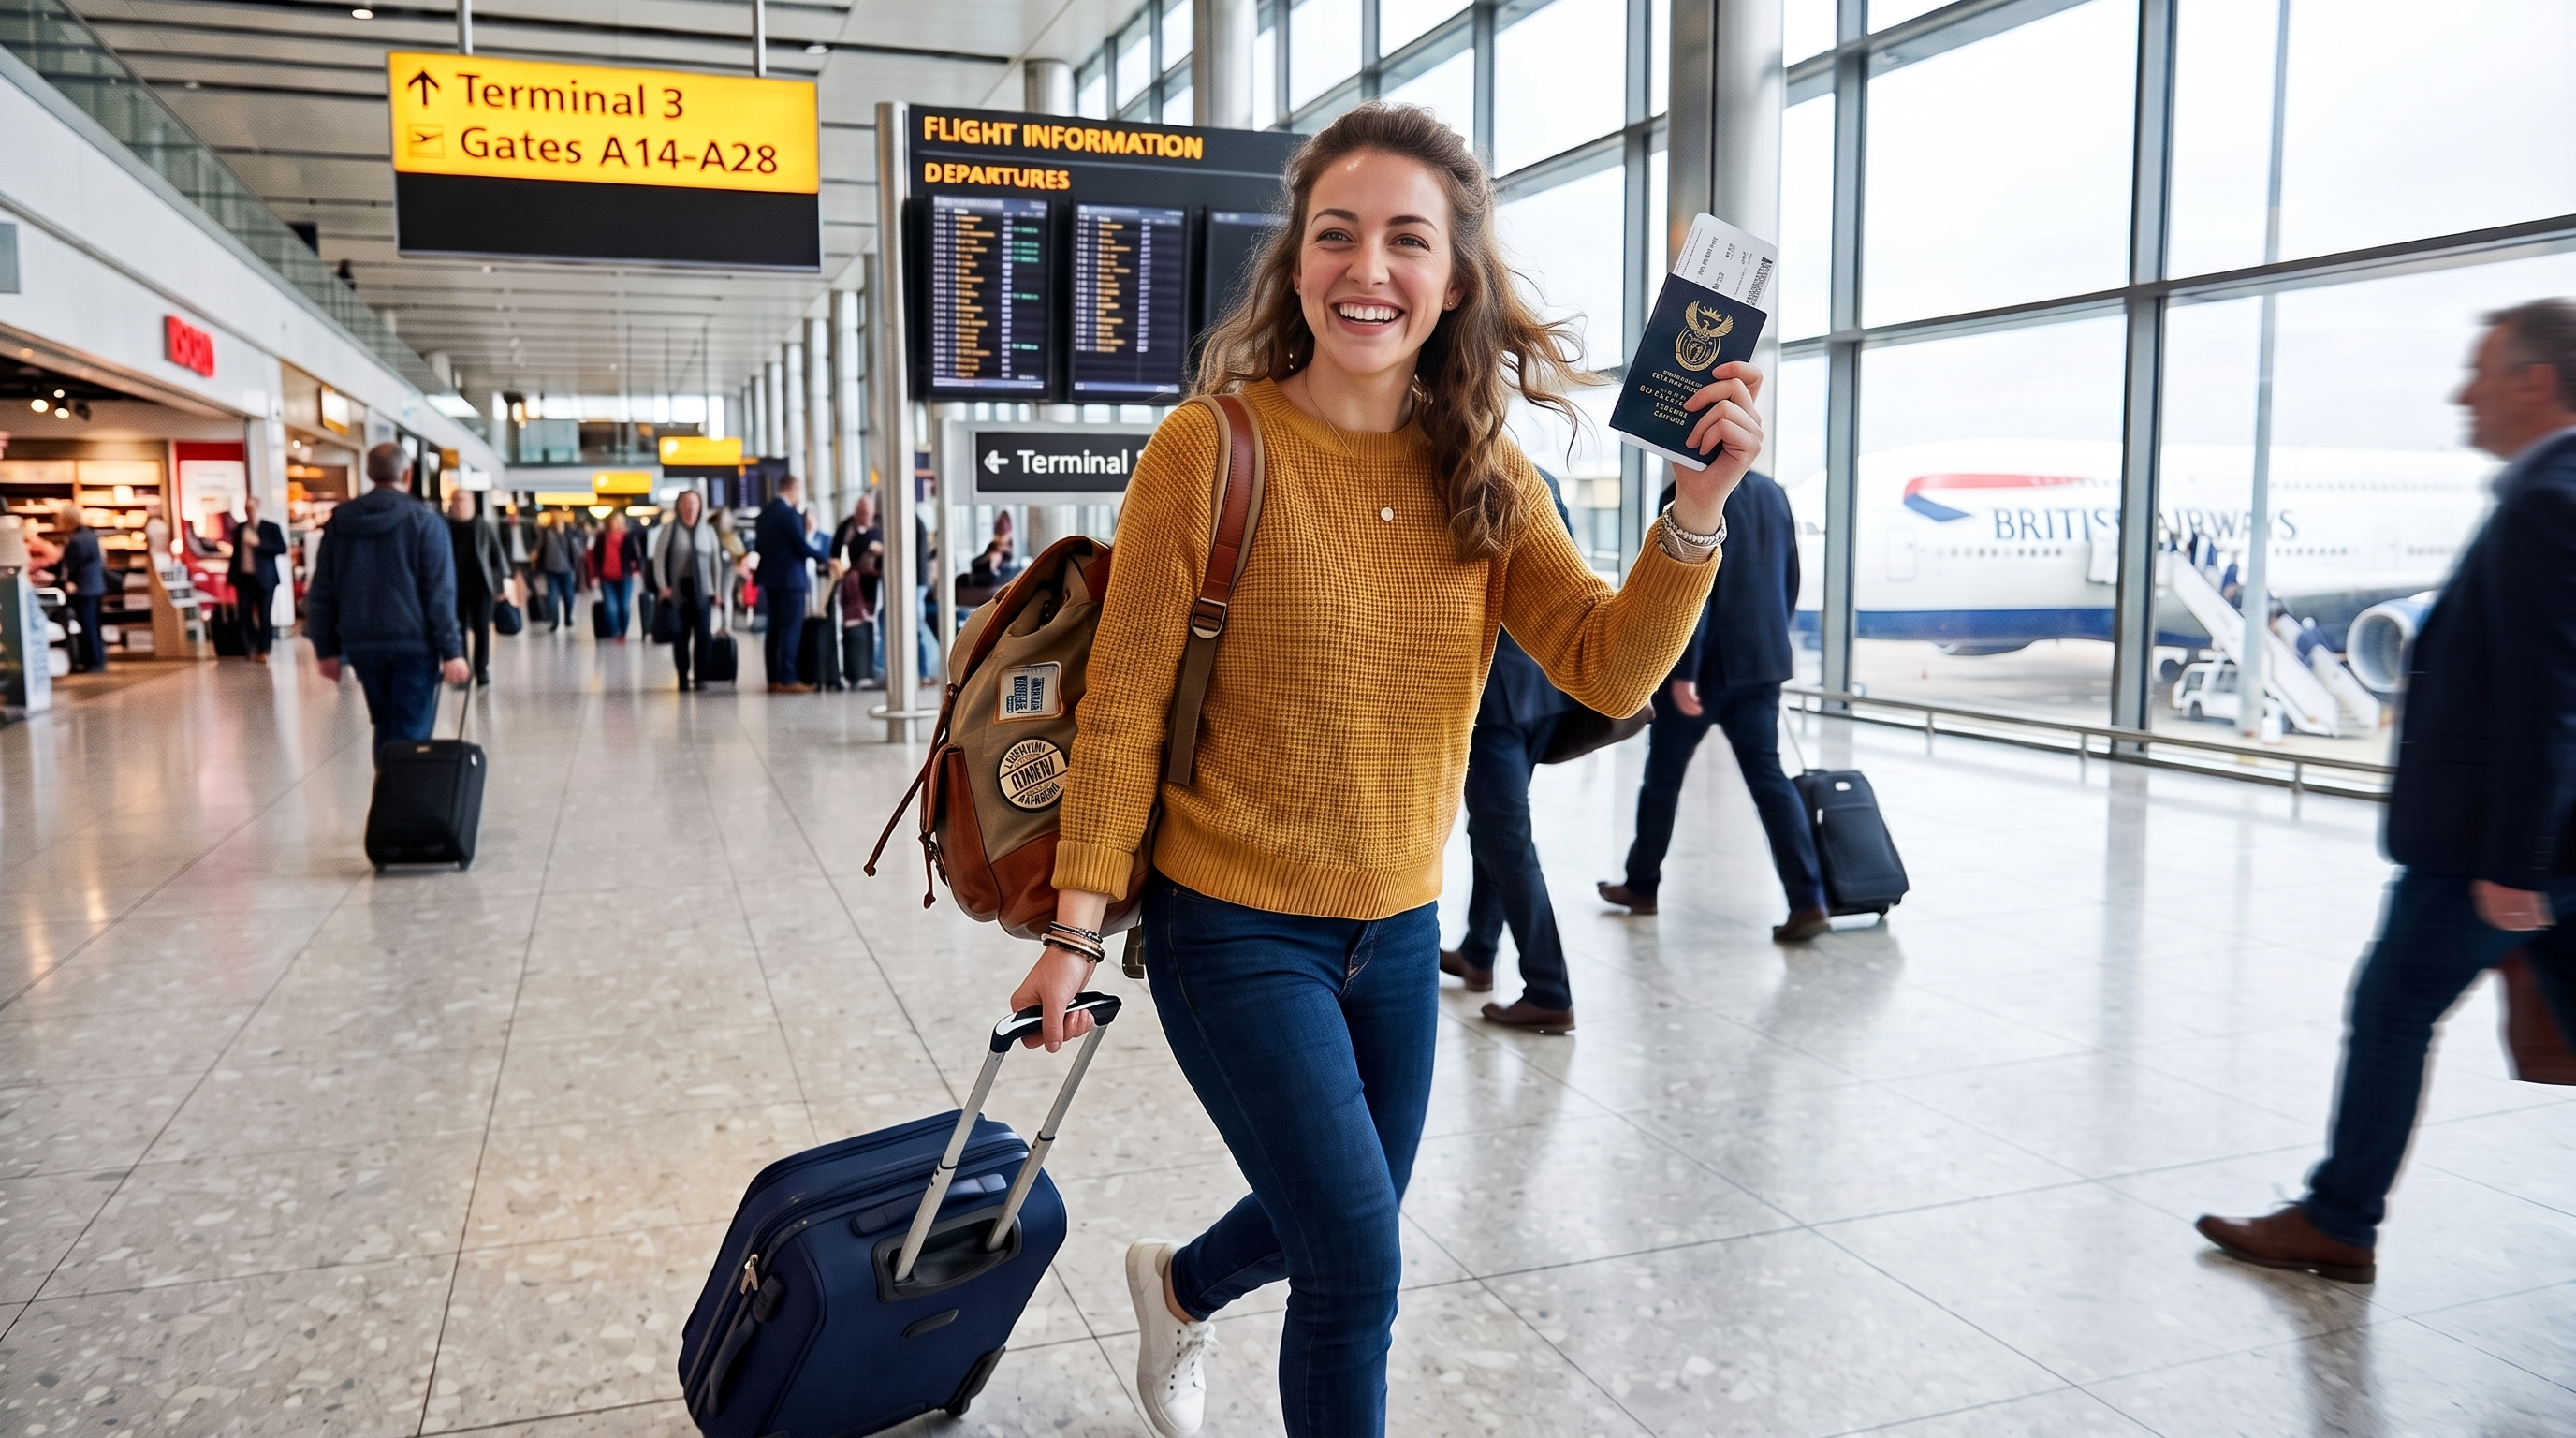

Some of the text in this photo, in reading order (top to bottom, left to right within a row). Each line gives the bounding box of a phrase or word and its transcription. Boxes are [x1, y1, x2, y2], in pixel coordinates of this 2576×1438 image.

[456, 73, 684, 120] Terminal 3
[461, 126, 779, 175] Gates A14-A28
[924, 116, 1204, 160] FLIGHT INFORMATION
[924, 162, 1071, 190] DEPARTURES
[1017, 448, 1129, 475] Terminal
[1995, 508, 2121, 540] BRITIS
